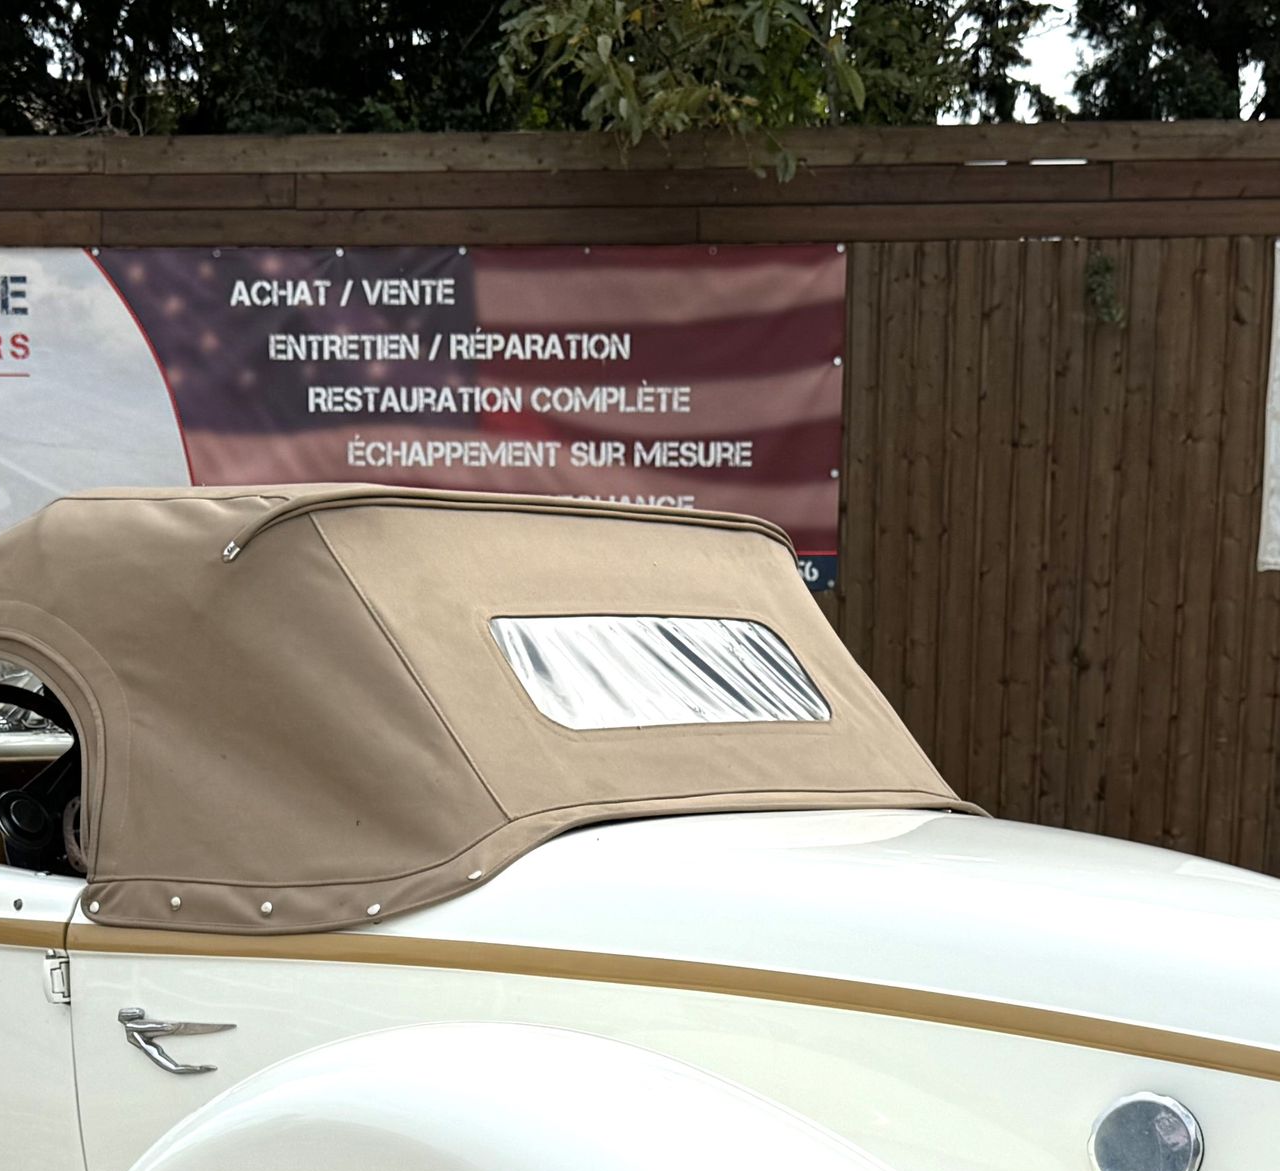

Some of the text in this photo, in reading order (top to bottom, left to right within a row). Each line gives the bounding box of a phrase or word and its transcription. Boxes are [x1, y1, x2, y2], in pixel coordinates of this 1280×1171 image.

[230, 278, 455, 307] ACHAT / VENTE
[269, 326, 631, 361] ENTRETIEN / RÉPARATION
[308, 379, 691, 413] RESTAURATION COMPLÈTE
[347, 434, 753, 468] ÉCHAPPEMENT SUR MESURE
